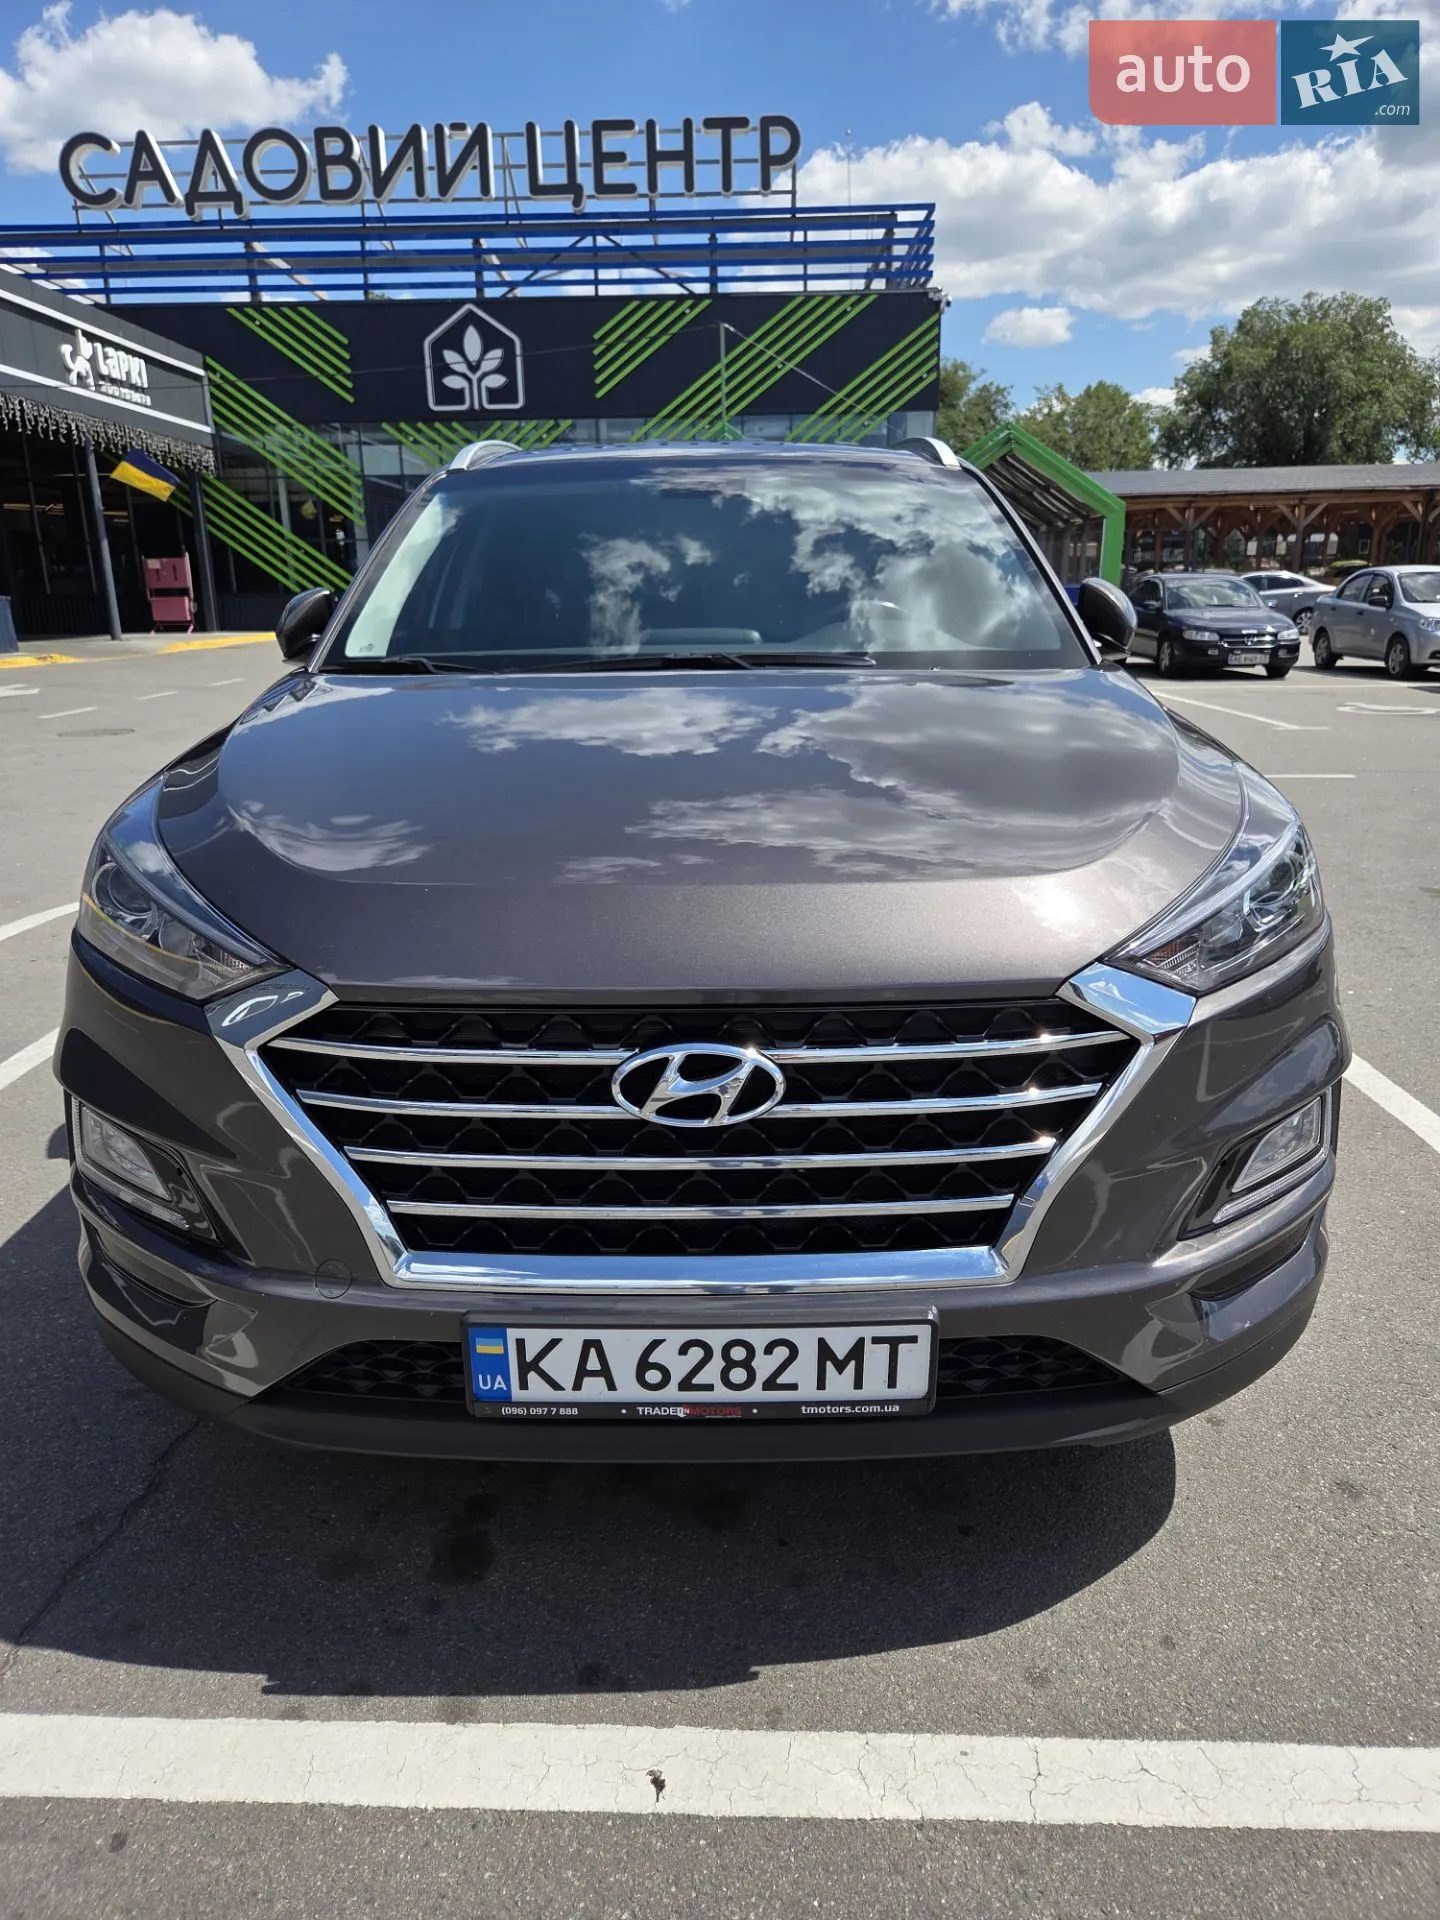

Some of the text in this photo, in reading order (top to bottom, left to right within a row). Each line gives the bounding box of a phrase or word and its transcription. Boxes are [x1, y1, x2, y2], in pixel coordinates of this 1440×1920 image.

[58, 115, 801, 222] САДОВИЙ ЦЕНТР
[515, 1335, 919, 1393] KA 6282 MT
[478, 1374, 508, 1391] UA
[501, 1406, 579, 1416] (096) 097 7 888
[801, 1404, 900, 1415] tmotors.com.ua
